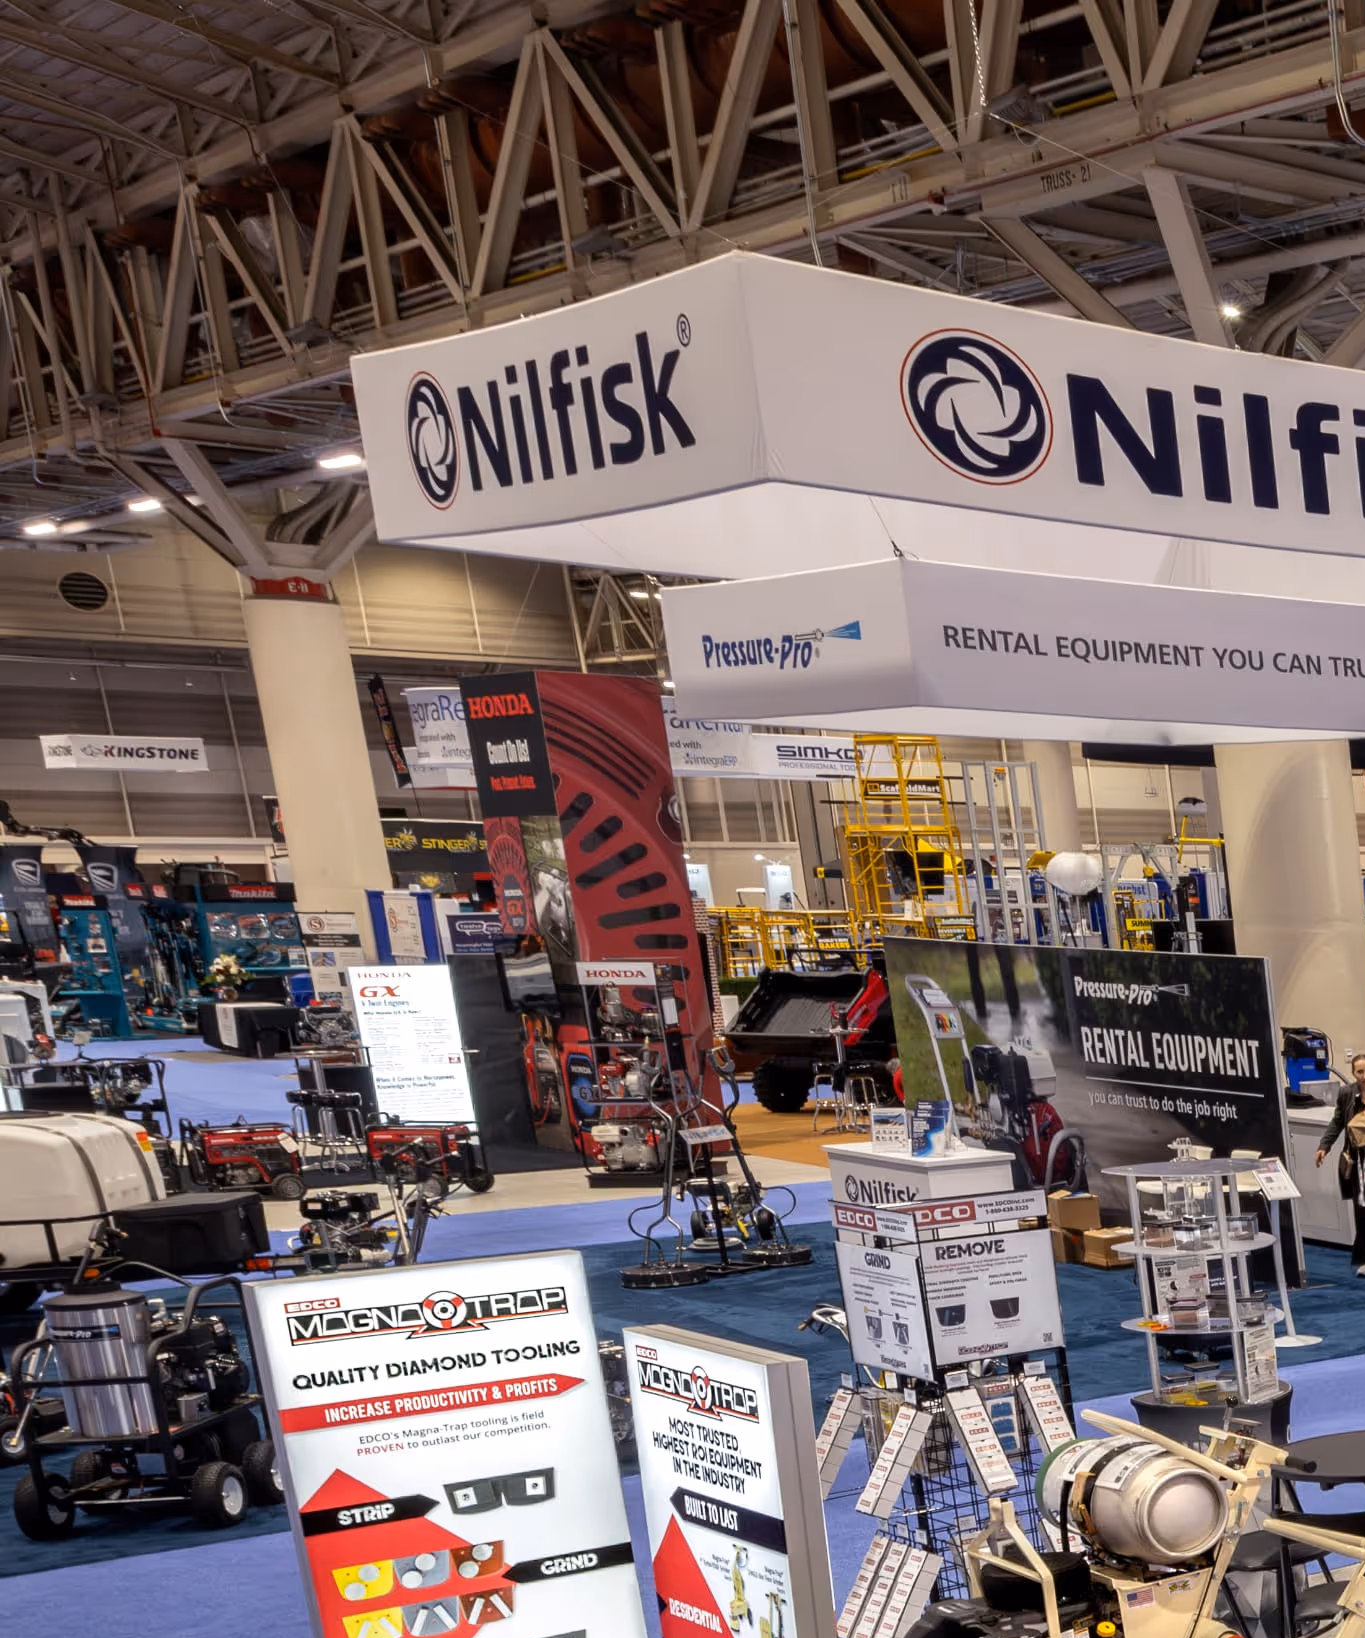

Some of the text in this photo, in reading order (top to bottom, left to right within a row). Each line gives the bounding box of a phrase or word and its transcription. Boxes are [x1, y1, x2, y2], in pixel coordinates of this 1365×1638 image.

[457, 331, 696, 492] Nilfisk
[702, 633, 813, 671] Pressure-Pro
[942, 625, 1049, 658] RENTAL
[1057, 635, 1205, 668] EQUIPMENT
[1212, 647, 1265, 673] YOU
[1272, 650, 1323, 676] CAN
[467, 693, 534, 720] HONDA
[422, 838, 469, 850] STINGER
[359, 985, 401, 997] GX
[585, 970, 647, 979] HONDA
[1074, 976, 1152, 1006] Pressure-Pro
[1081, 1026, 1260, 1079] RENTAL EQUIPMENT
[1088, 1090, 1238, 1122] you can trust to do the job right
[836, 1208, 874, 1228] EDCO
[935, 1239, 1005, 1261] REMOVE
[288, 1300, 338, 1313] EDCO
[293, 1340, 580, 1390] QUALITY DIAMOND TOOLING
[324, 1378, 558, 1424] INCREASE PRODUCTIVITY & PROFITS
[357, 1422, 551, 1457] PROVEN to outlast our competition.
[359, 1410, 545, 1445] EDCO's Magna-Trap tooling is field
[668, 1416, 694, 1439] MOST
[653, 1431, 762, 1479] HIGHEST ROI EQUIPMENT
[673, 1456, 745, 1494] IN THE INDUSTRY
[337, 1503, 395, 1526] STRIP
[684, 1495, 738, 1531] BUILT TO LAST
[540, 1553, 598, 1575] GRIND
[669, 1598, 723, 1634] RESIDENTIAL
